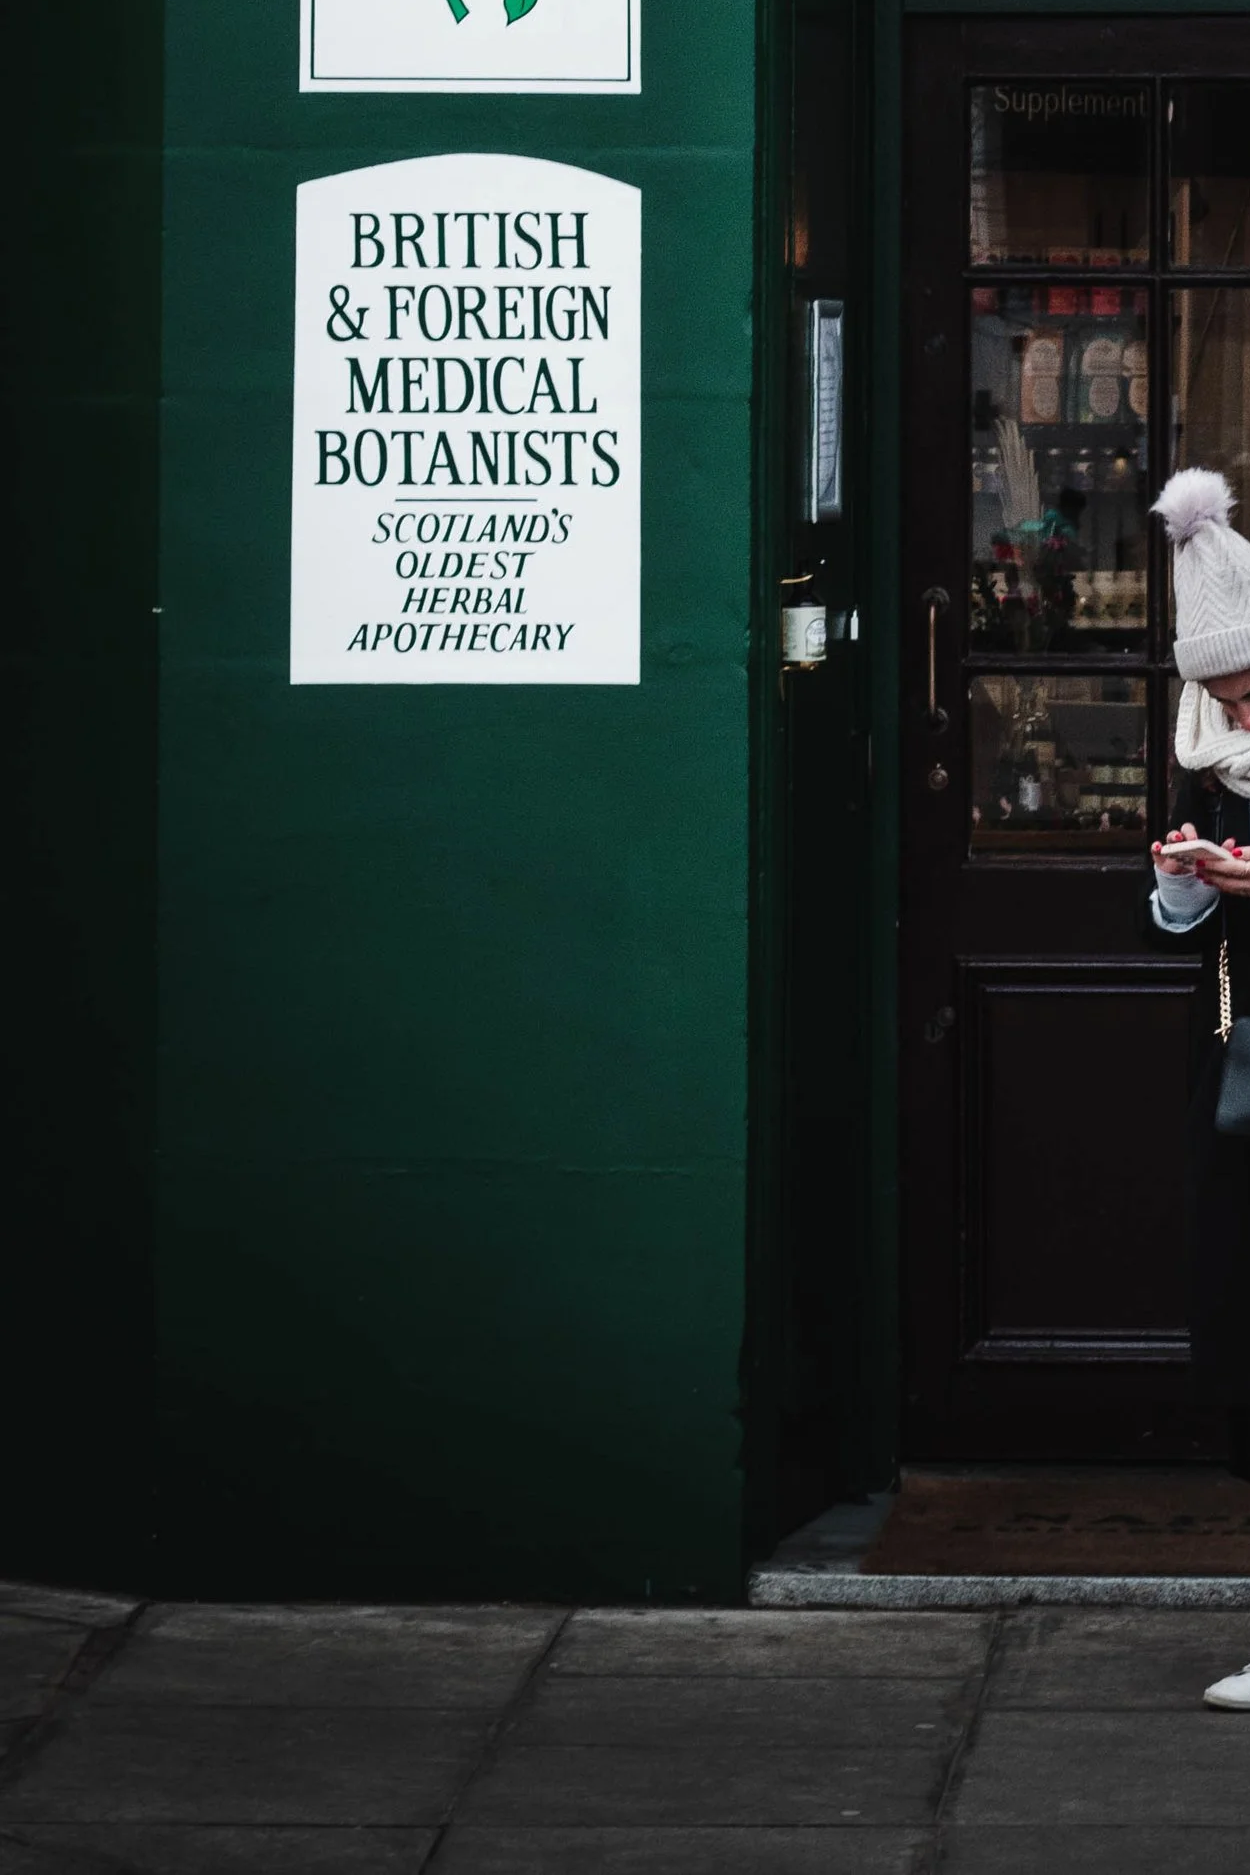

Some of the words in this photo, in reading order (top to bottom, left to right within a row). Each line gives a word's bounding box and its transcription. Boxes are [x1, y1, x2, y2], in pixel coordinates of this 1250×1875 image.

[994, 85, 1145, 121] Supplement
[350, 212, 589, 270] BRITISH
[327, 285, 369, 341] &
[384, 285, 611, 341] FOREIGN
[346, 357, 597, 415] MEDICAL
[315, 429, 619, 487] BOTANISTS
[372, 508, 572, 543] SCOTLAND'S
[396, 551, 534, 579] OLDEST
[402, 588, 528, 614] HERBAL
[347, 623, 574, 653] APOTHECARY
